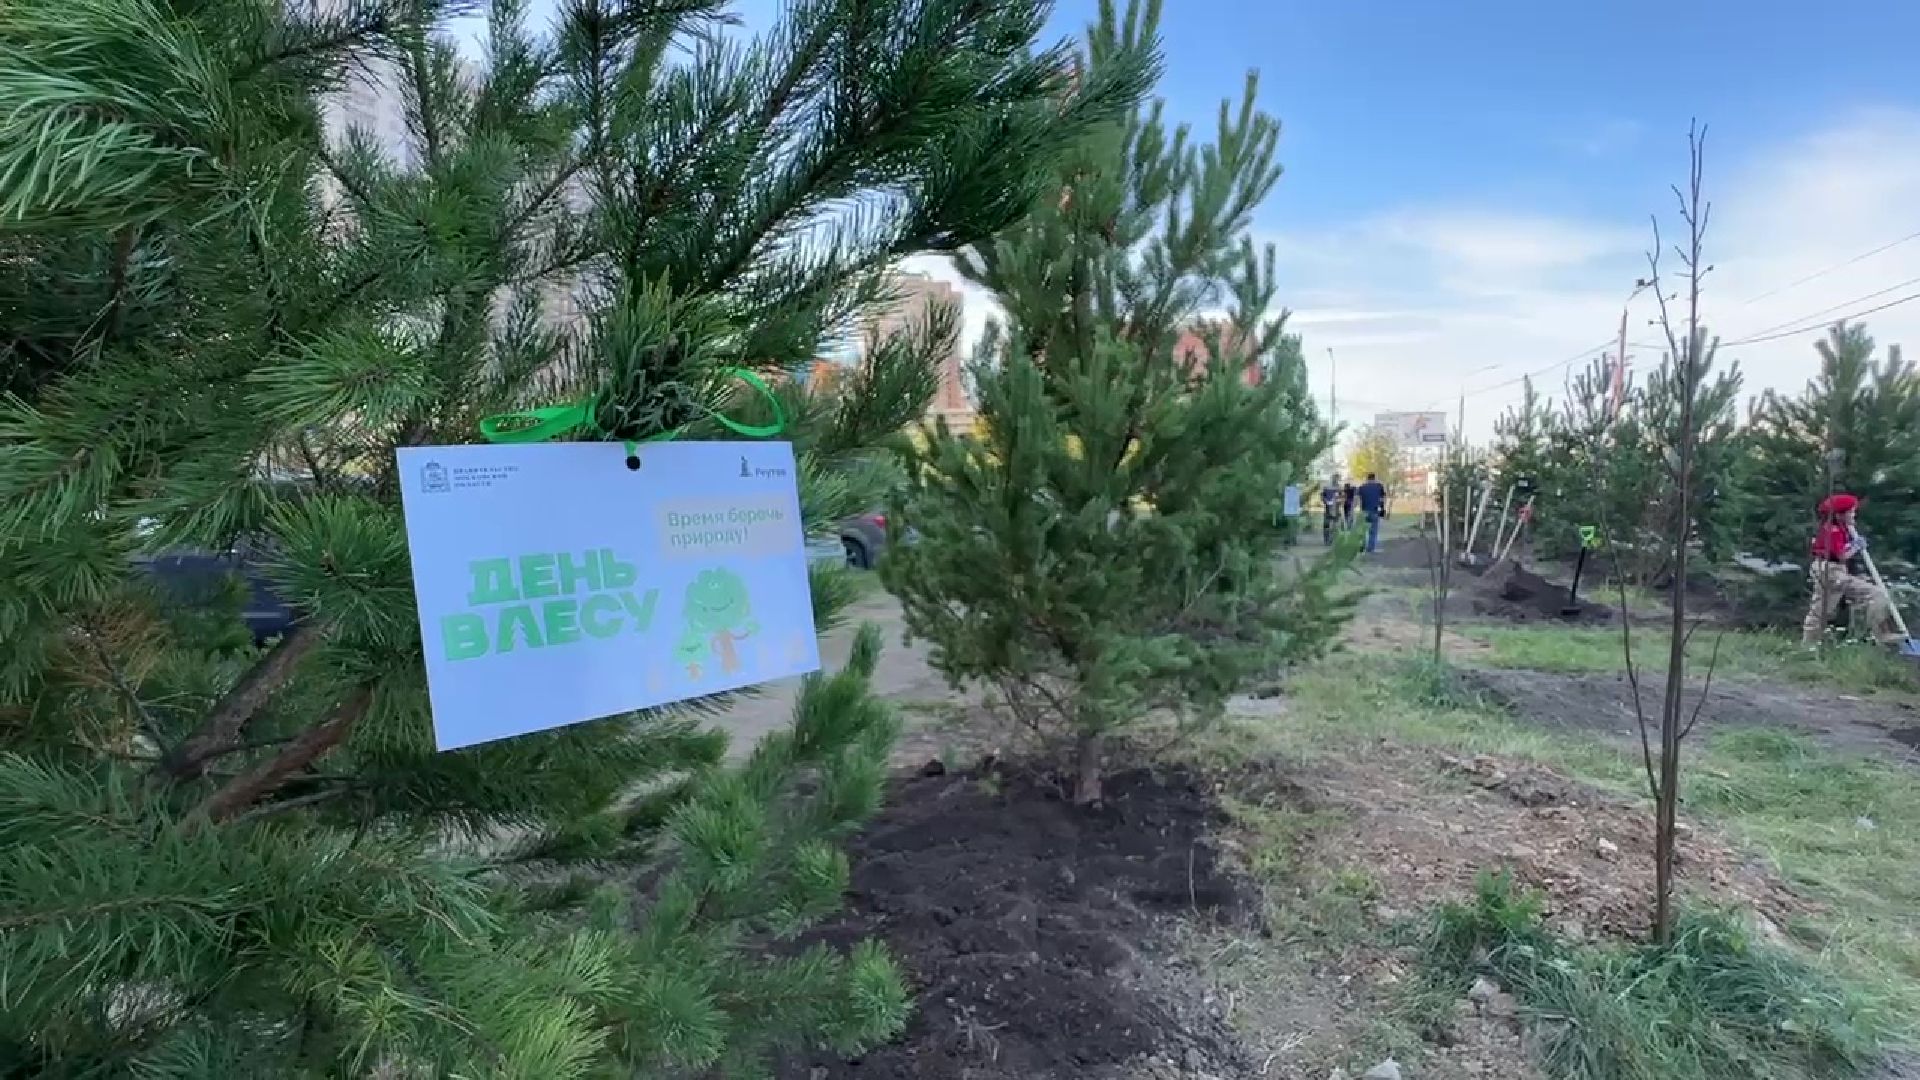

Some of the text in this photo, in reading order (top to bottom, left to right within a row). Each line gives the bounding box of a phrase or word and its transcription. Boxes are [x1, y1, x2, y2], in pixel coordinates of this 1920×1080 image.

[668, 507, 783, 528] Время беречь
[671, 526, 748, 549] природу!
[468, 548, 637, 606] ДЕНЬ
[441, 589, 658, 661] В ЛЕСУ
